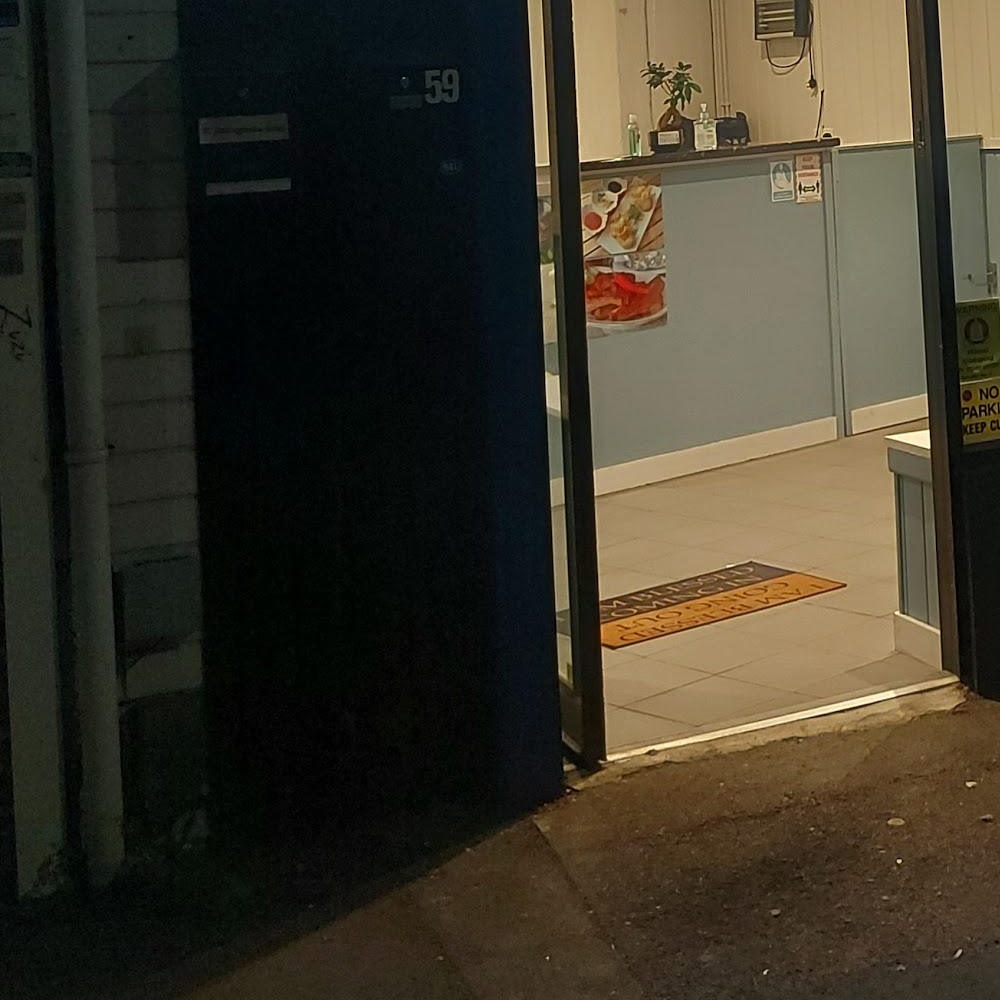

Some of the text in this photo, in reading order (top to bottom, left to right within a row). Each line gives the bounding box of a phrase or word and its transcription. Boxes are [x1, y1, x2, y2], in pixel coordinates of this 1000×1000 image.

[424, 69, 460, 104] 59
[979, 385, 999, 401] NO
[600, 586, 724, 617] OMING
[755, 588, 802, 605] AM
[616, 611, 682, 632] OUT
